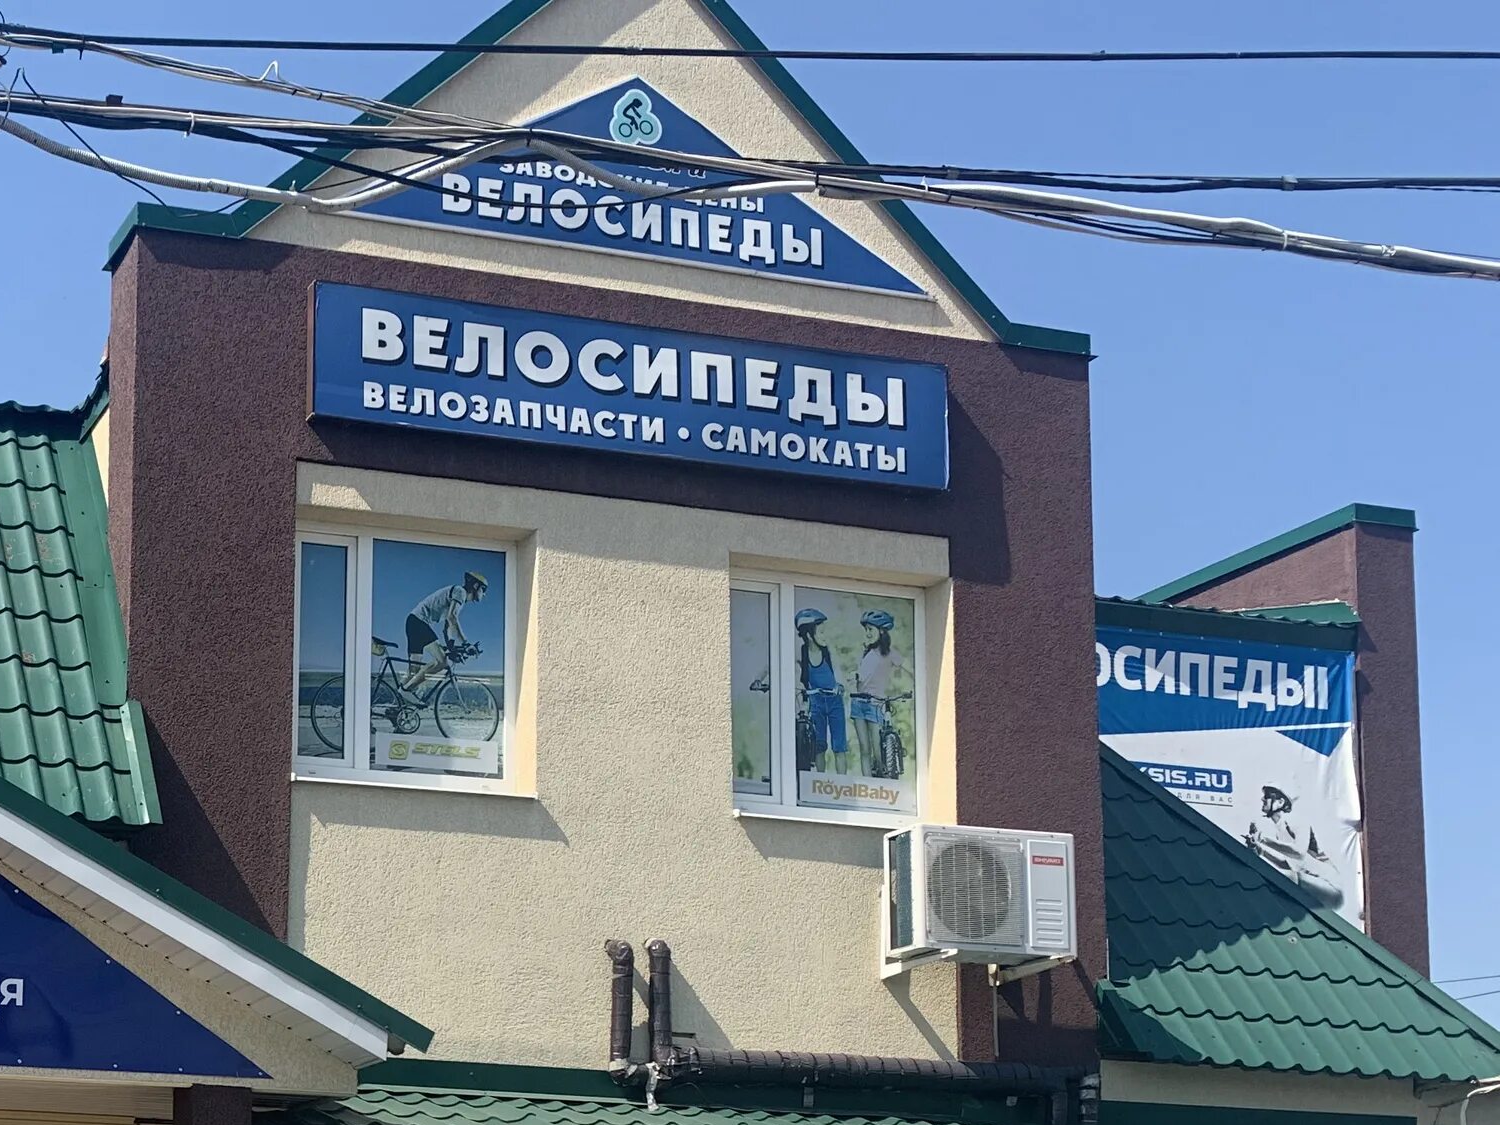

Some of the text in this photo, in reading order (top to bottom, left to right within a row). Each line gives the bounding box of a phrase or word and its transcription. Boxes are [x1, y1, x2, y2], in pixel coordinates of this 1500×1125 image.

[442, 173, 823, 267] ВЕЛОСИПЕДЫ
[362, 308, 905, 427] ВЕЛОСИПЕДЫ
[363, 381, 906, 473] ВЕЛОЗАПЧАСТИ САМОКАТЫ
[811, 779, 900, 804] RoyalBaby
[1140, 767, 1228, 788] SIS.RU
